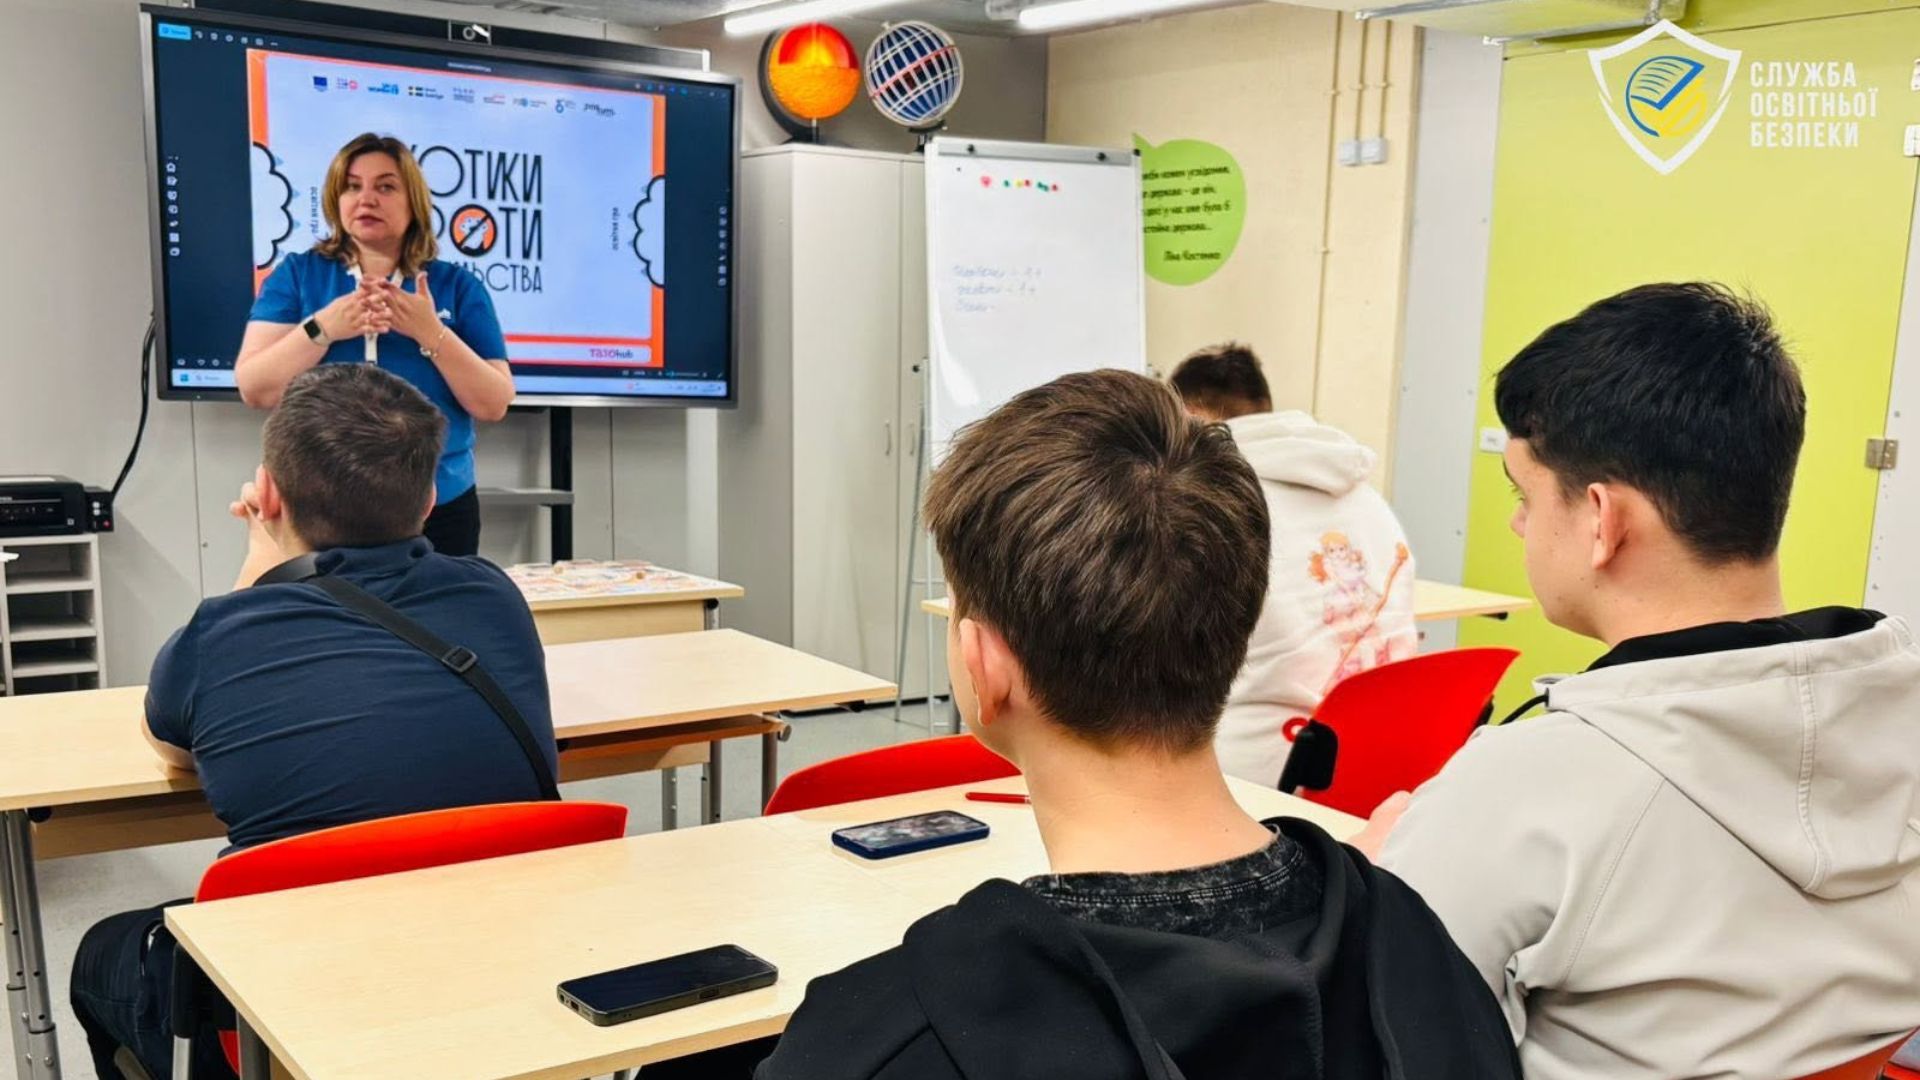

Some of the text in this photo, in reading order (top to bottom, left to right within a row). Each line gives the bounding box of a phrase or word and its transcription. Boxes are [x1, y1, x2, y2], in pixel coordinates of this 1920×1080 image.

[411, 144, 543, 204] ОТИКИ
[1182, 249, 1221, 260] Костенко
[454, 260, 543, 294] ЬСТВА
